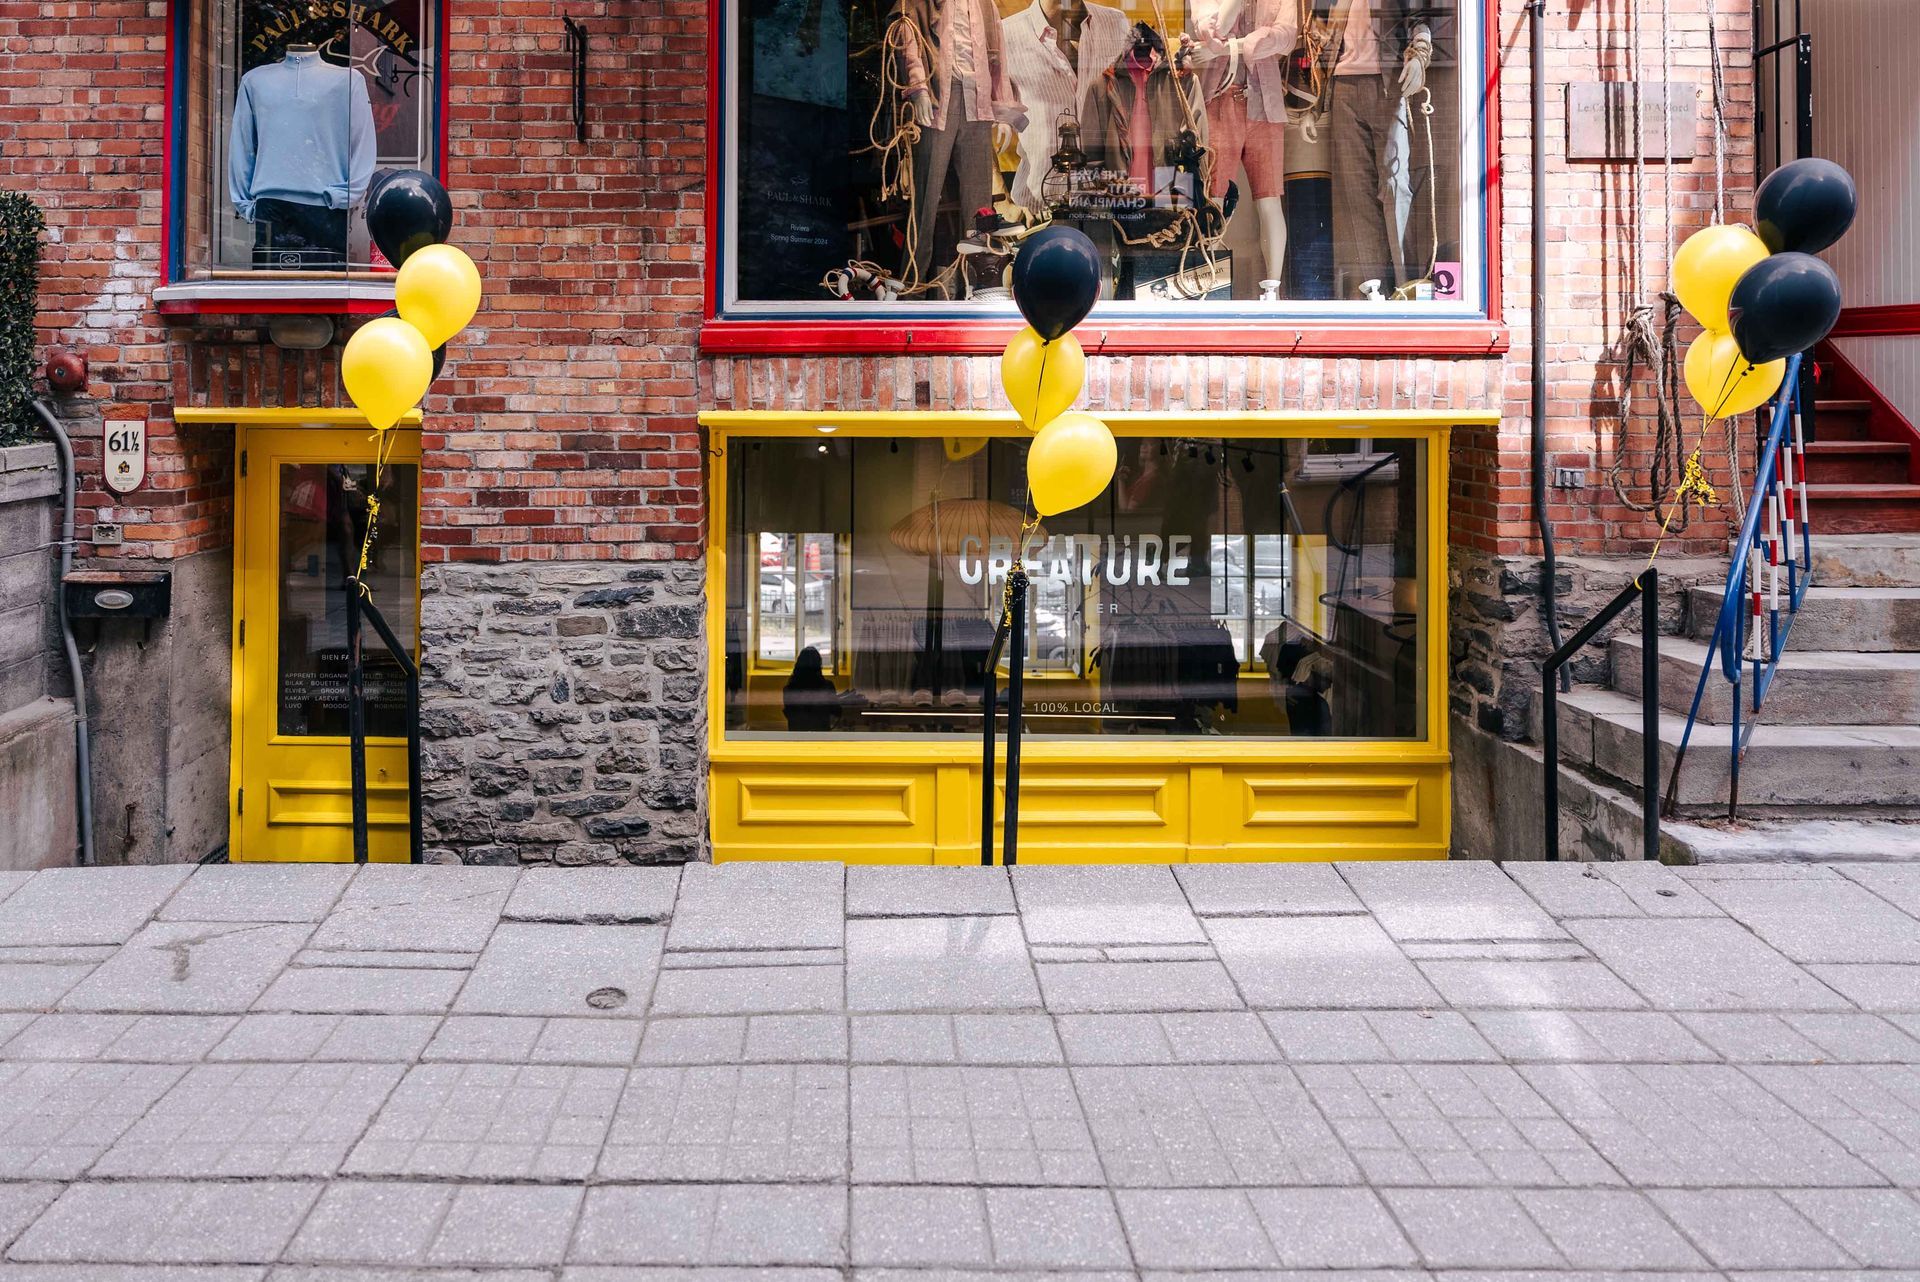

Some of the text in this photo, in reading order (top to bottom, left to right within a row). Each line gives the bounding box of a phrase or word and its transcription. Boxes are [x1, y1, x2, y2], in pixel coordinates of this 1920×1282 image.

[251, 8, 304, 52] PAUL
[332, 0, 414, 55] SHARK
[959, 534, 1192, 586] CREATURE
[1033, 702, 1119, 713] 100% LOCAL
